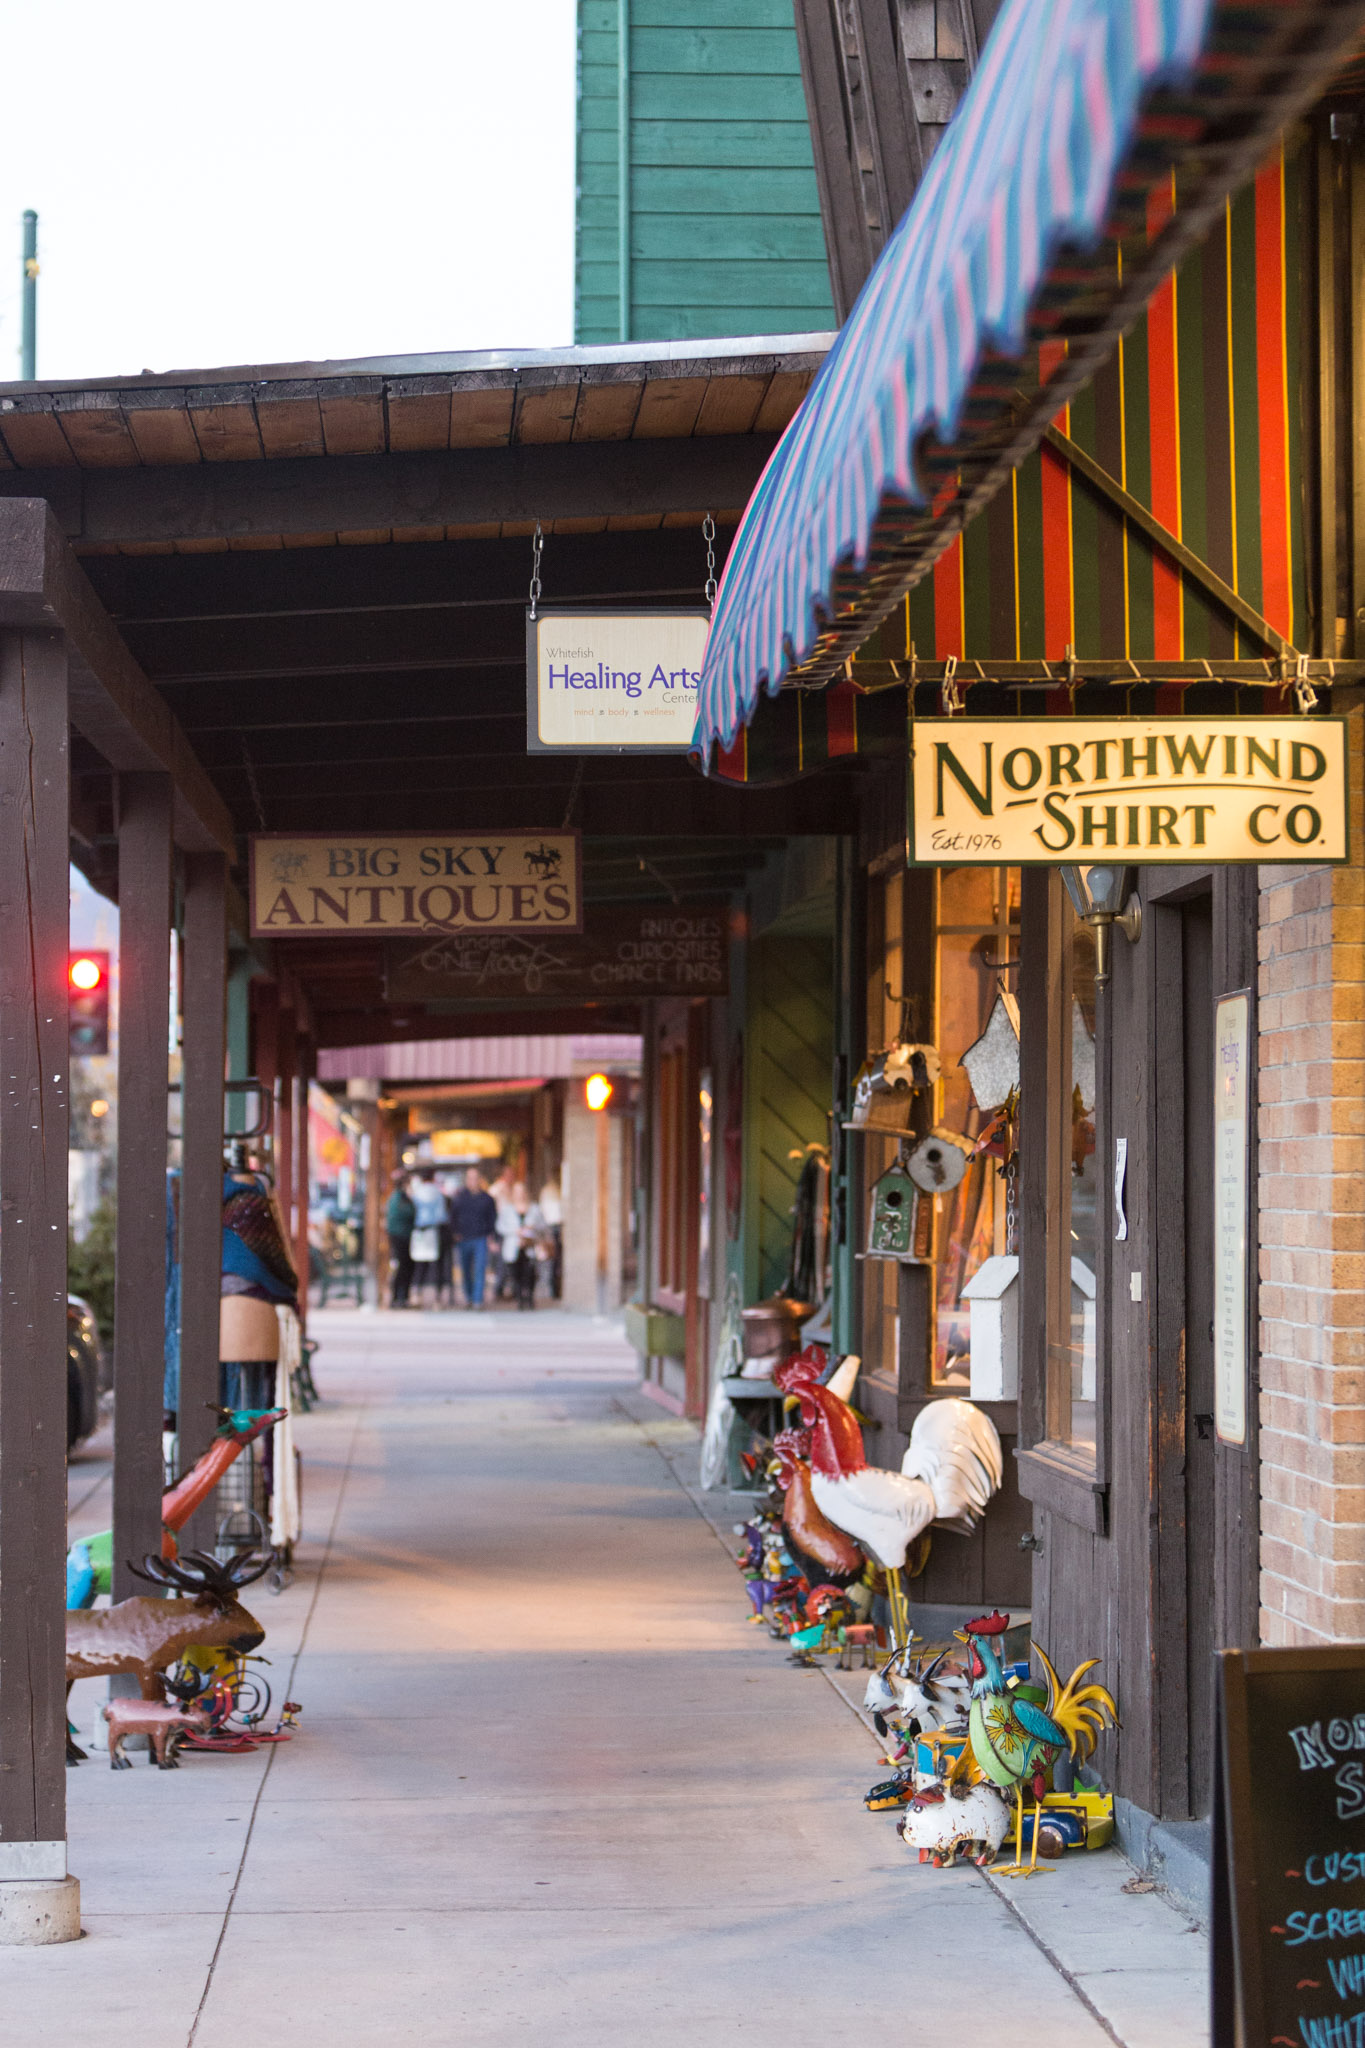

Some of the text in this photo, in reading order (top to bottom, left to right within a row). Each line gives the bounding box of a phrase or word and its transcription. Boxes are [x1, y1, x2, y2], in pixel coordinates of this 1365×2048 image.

[546, 647, 594, 659] Whitefish
[548, 662, 701, 698] Healing Arts
[574, 707, 676, 719] mind body wellness
[932, 733, 1328, 817] NORTHWIND
[1033, 791, 1326, 852] SHIRT CO.
[326, 846, 506, 878] BIG SKY
[262, 884, 571, 932] ANTIQUES
